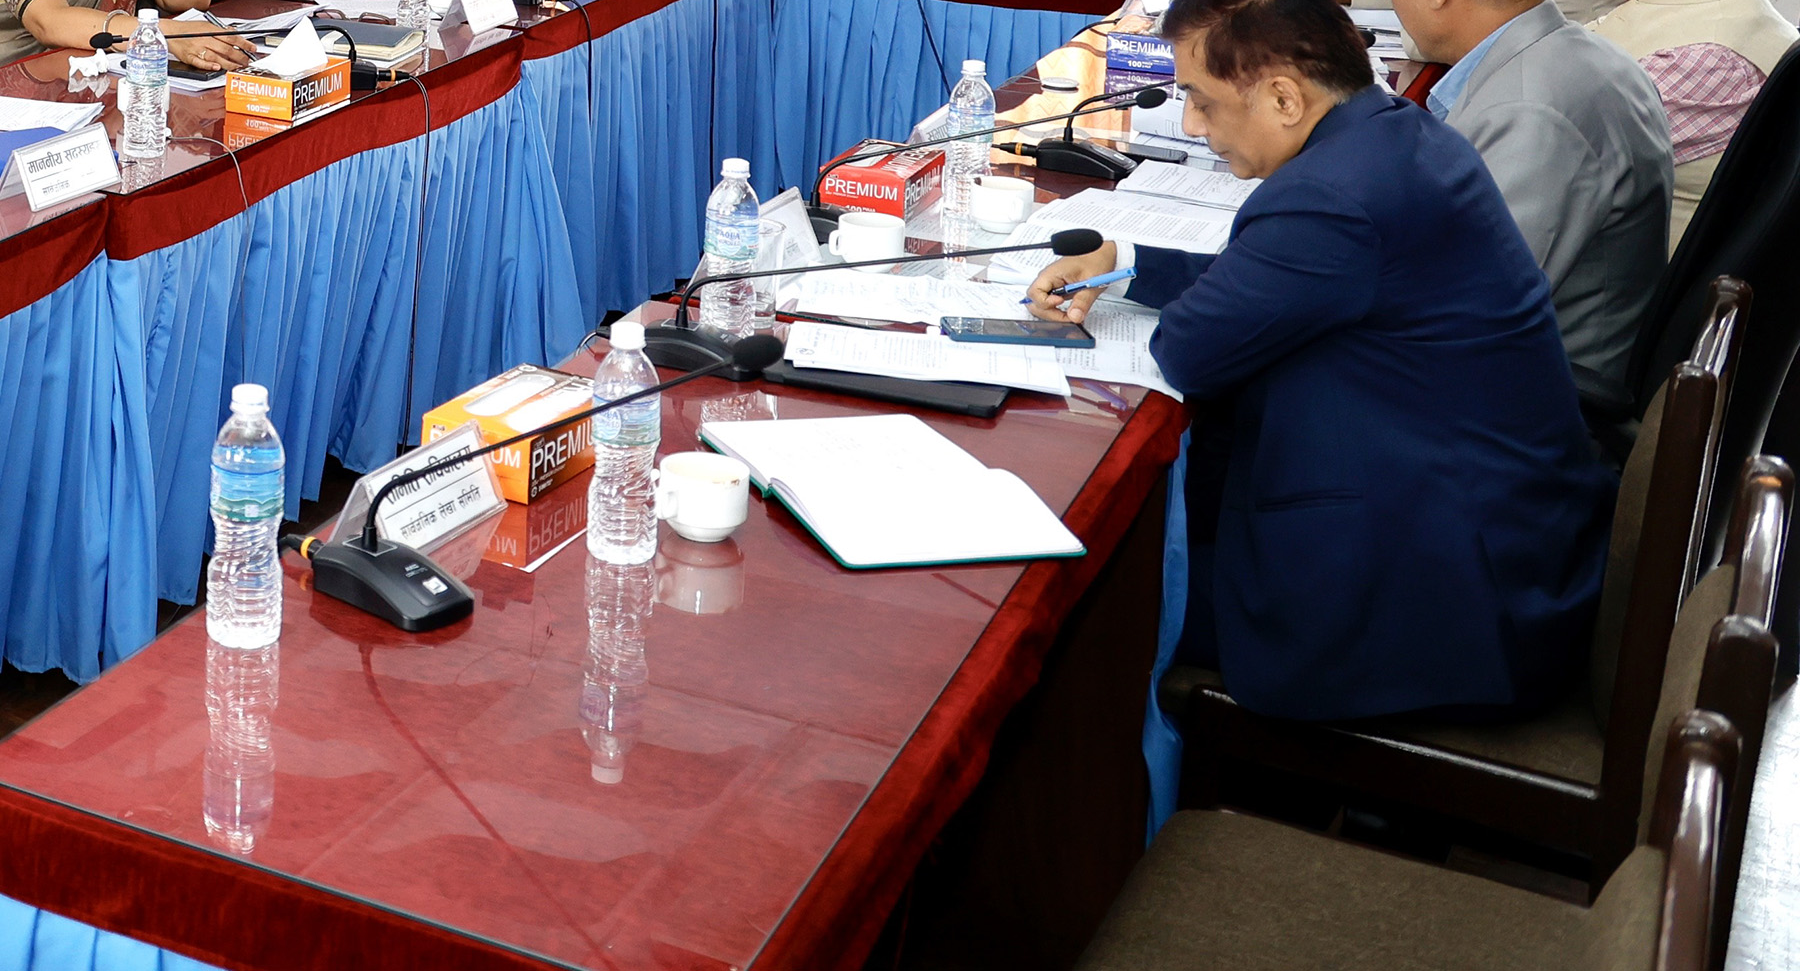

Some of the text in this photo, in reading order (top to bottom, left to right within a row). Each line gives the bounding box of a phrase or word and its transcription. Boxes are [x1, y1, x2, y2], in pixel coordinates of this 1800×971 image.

[1110, 39, 1172, 54] PREMIUM
[1127, 60, 1142, 68] 100
[230, 78, 287, 100] PREMIUM
[293, 70, 343, 107] PREMIUM
[246, 104, 260, 112] 100
[27, 151, 63, 174] माननीय
[825, 178, 898, 201] PREMIUM
[904, 164, 941, 208] PREMIUM
[530, 418, 595, 480] PREMIU
[400, 484, 482, 540] सार्वजनिक लेखा समिति
